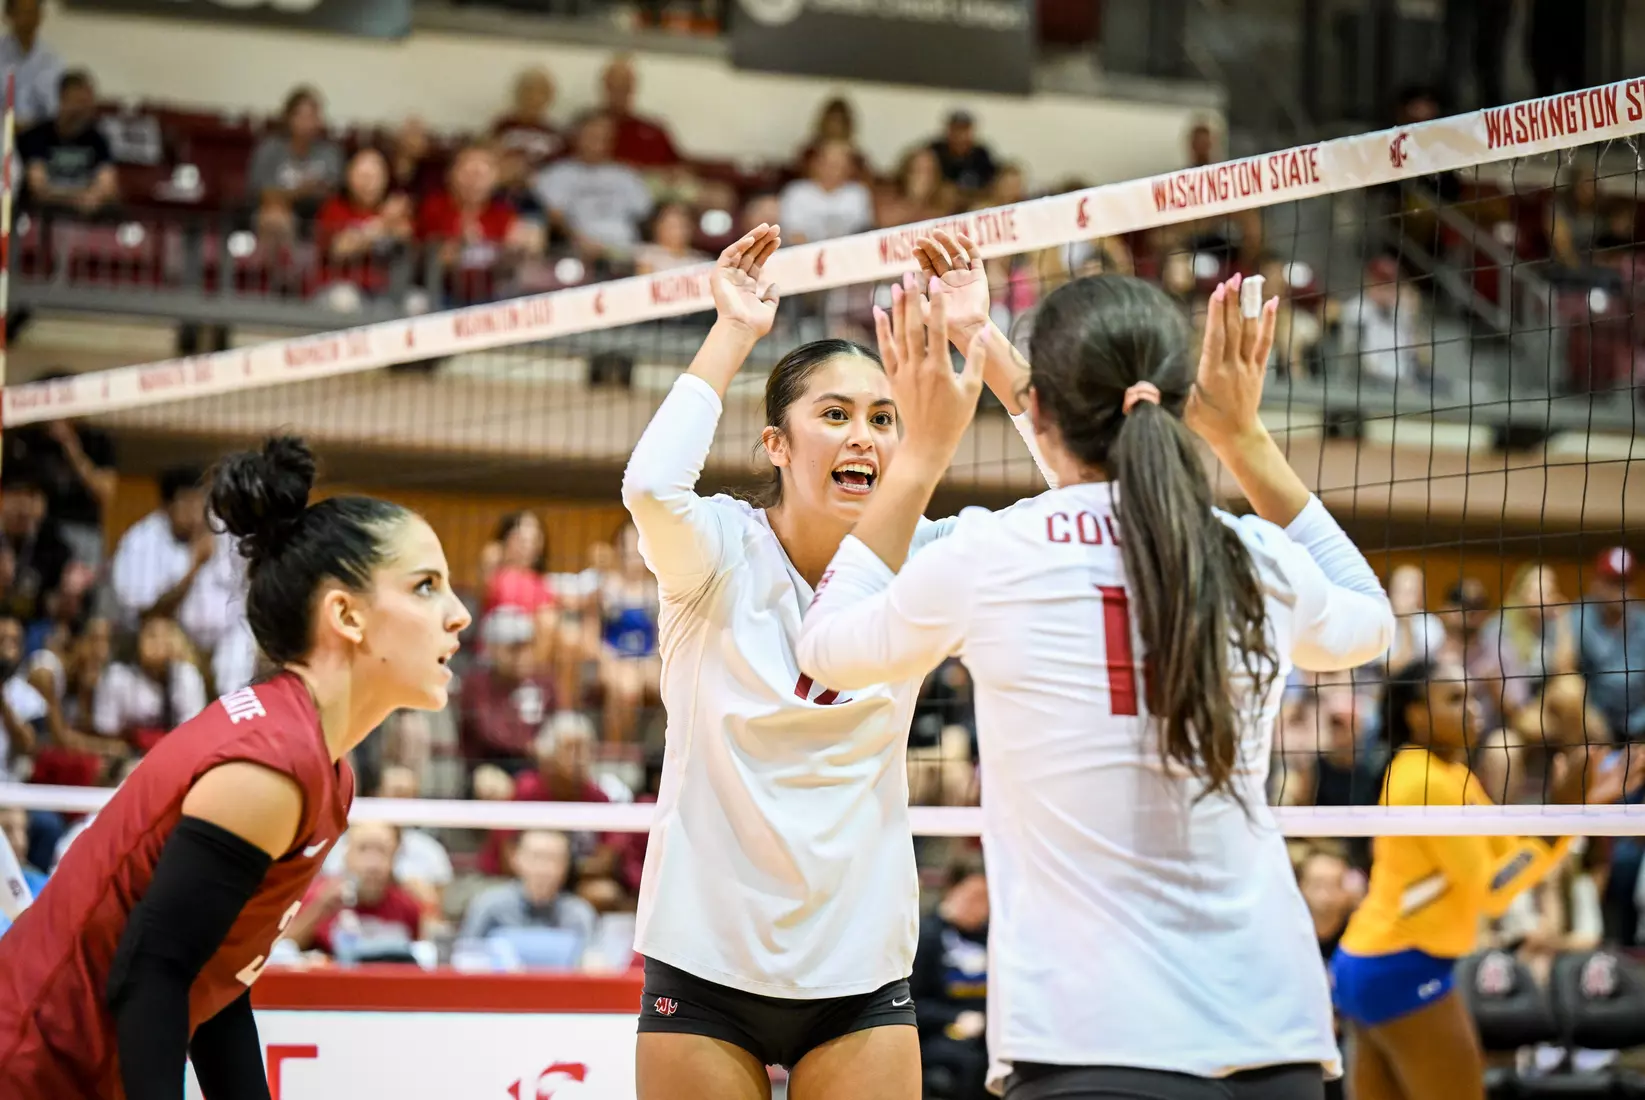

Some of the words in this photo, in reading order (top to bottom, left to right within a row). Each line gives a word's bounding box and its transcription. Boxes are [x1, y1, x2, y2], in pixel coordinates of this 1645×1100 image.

[1484, 85, 1619, 149] WASHINGTON
[1152, 159, 1263, 212] WASHINGTON
[1268, 148, 1320, 191] STATE
[975, 209, 1019, 247] STATE
